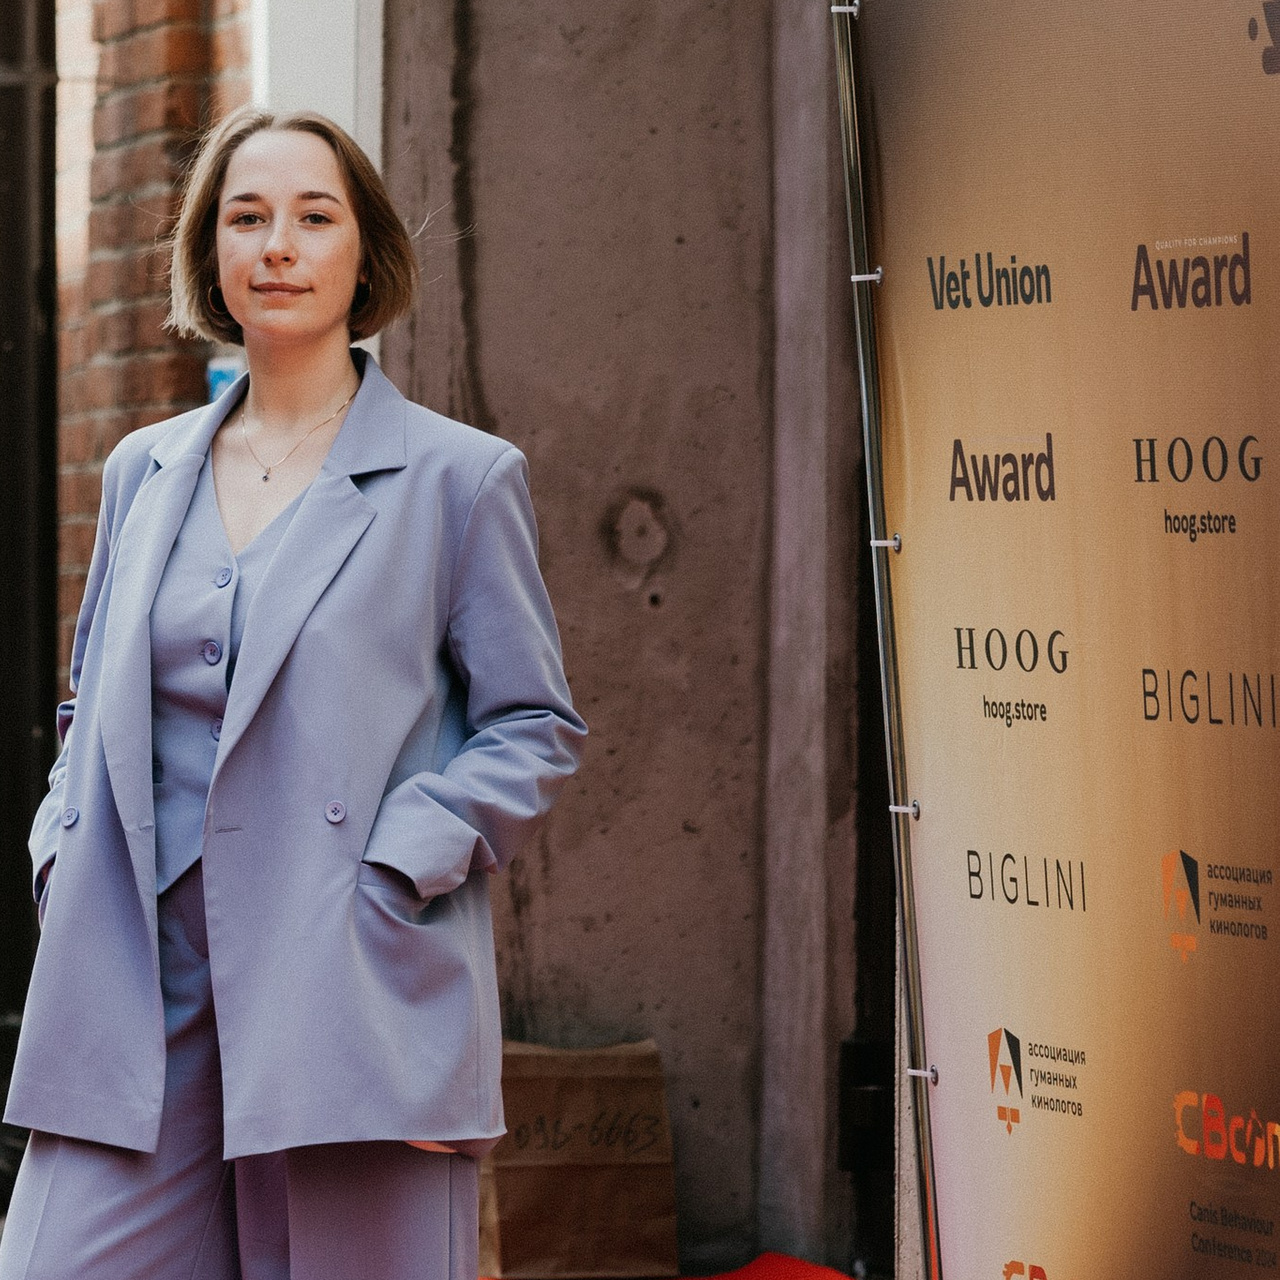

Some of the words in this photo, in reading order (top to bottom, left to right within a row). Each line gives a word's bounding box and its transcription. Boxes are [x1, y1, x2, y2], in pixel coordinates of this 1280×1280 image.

[1155, 239, 1182, 251] QUALITY
[1184, 237, 1197, 248] FOR
[1198, 234, 1238, 247] CHAMPIONS
[926, 255, 972, 310] Vet
[975, 252, 1052, 308] Union
[1131, 231, 1251, 311] Award
[949, 432, 1056, 502] Award
[1132, 435, 1264, 483] HOOG
[1164, 508, 1237, 543] hoog.store
[953, 627, 1069, 674] HOOG
[982, 694, 1047, 728] hoog.store
[1142, 668, 1276, 728] BIGLINI
[967, 849, 1086, 912] BIGLINI
[1207, 864, 1273, 885] ассоциация
[1208, 891, 1263, 912] гуманных
[1210, 920, 1268, 940] кинологов
[1028, 1042, 1086, 1065] ассоциация
[1030, 1068, 1078, 1090] гуманных
[1031, 1094, 1083, 1117] кинологов
[1189, 1200, 1218, 1225] Canis
[1220, 1206, 1275, 1236] Behaviour
[1191, 1231, 1254, 1264] Conference
